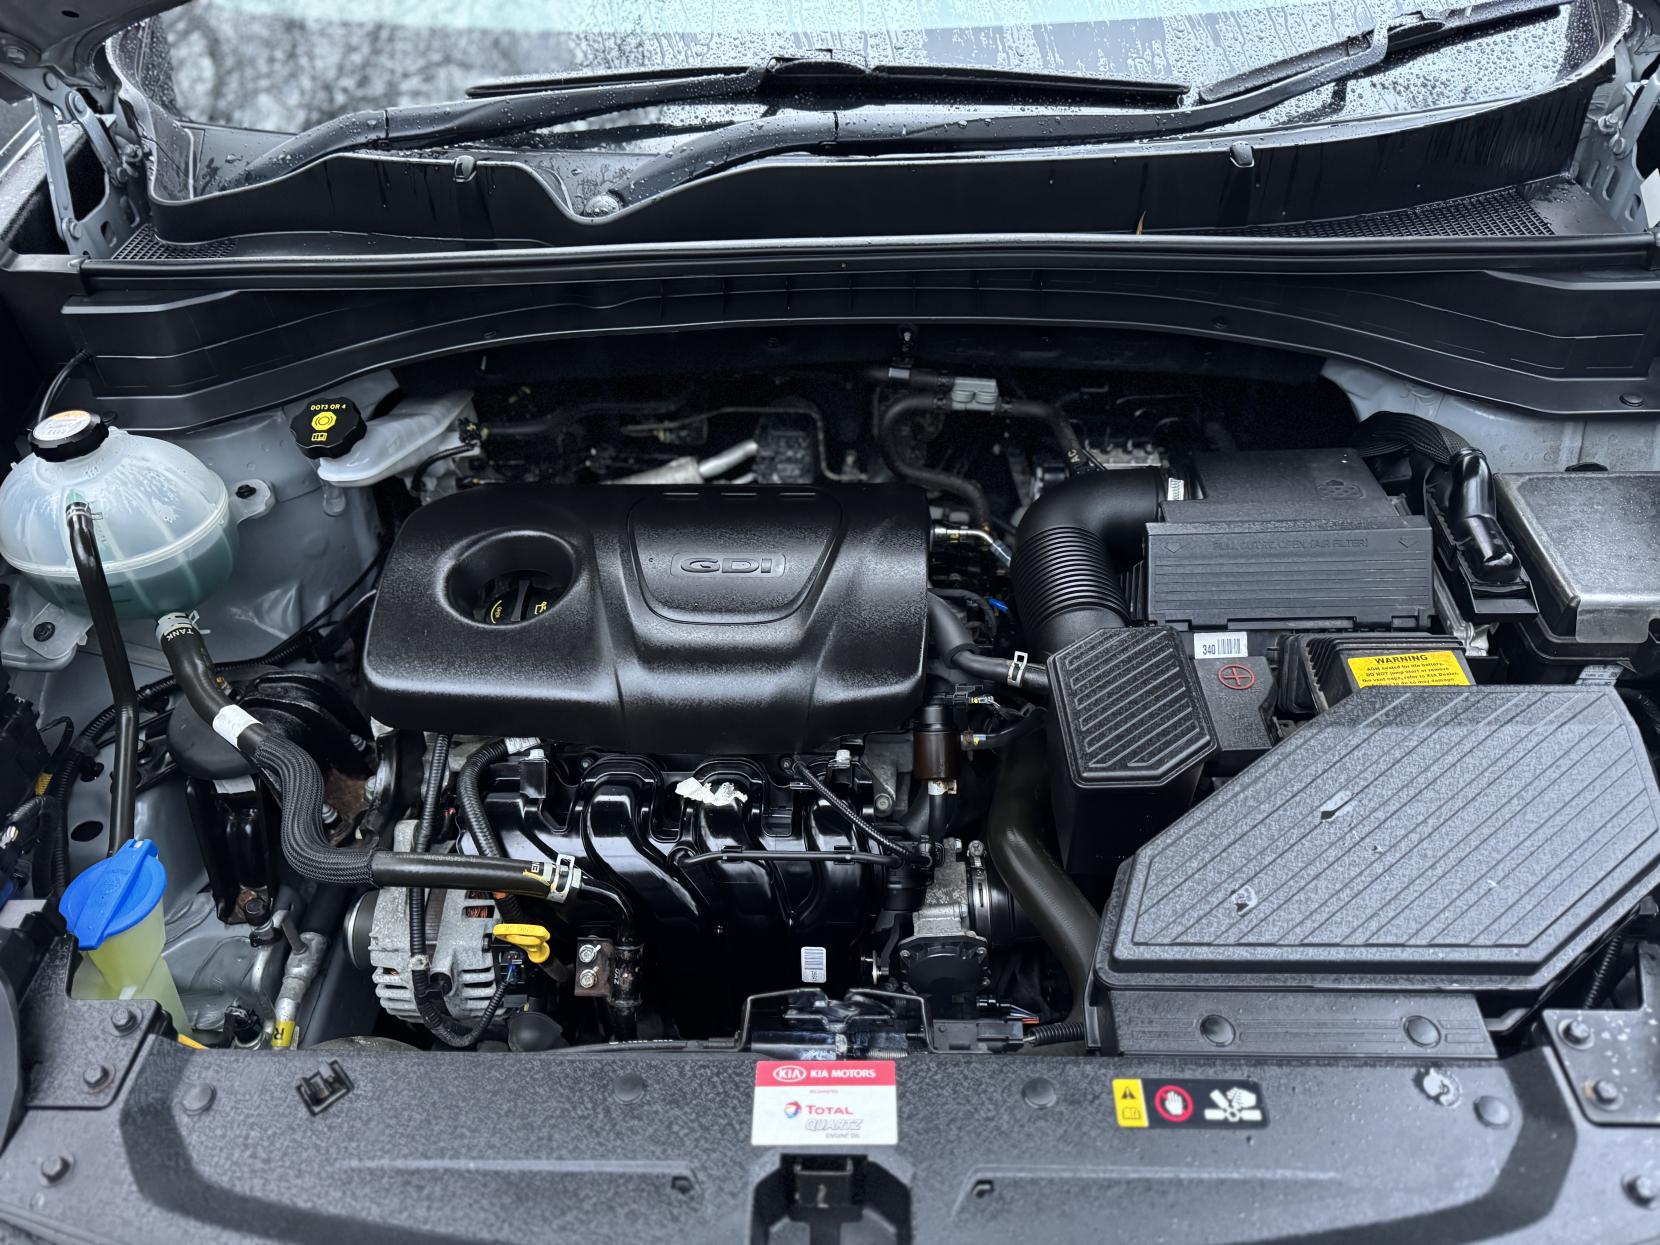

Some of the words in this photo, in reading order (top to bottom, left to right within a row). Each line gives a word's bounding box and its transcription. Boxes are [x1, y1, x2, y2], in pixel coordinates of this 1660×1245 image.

[681, 558, 772, 573] GDI
[166, 628, 194, 641] TANK
[1374, 654, 1428, 664] WARNING
[274, 1027, 285, 1040] R
[810, 1068, 829, 1079] KIA
[832, 1068, 876, 1079] MOTORS
[805, 1118, 864, 1131] QUARTZ
